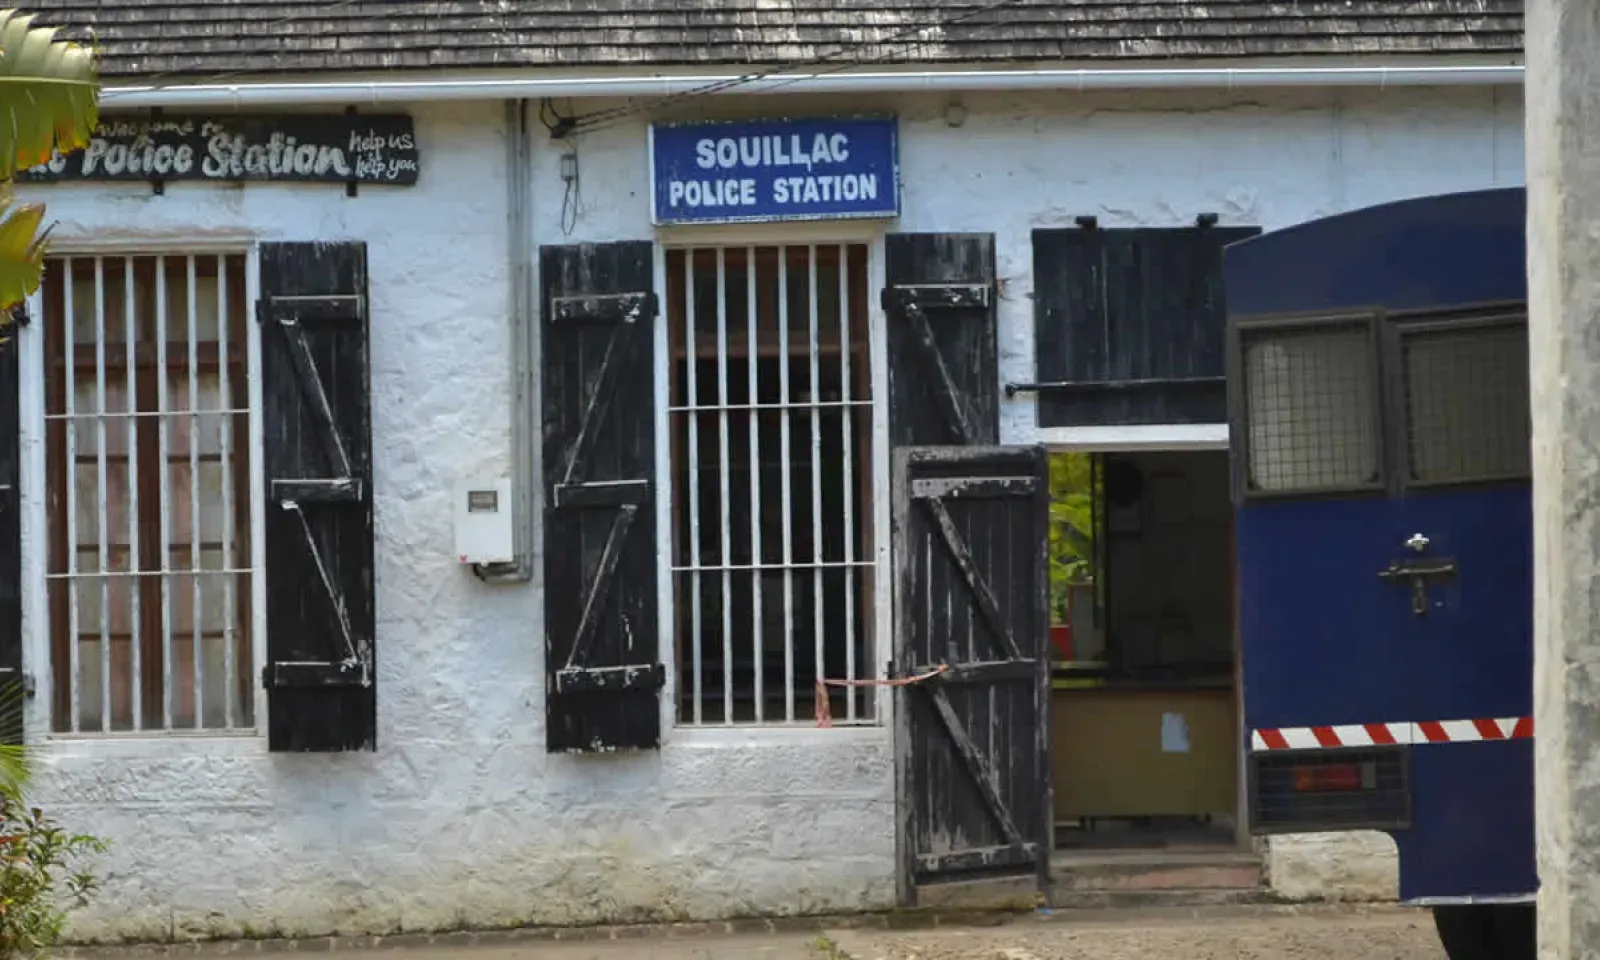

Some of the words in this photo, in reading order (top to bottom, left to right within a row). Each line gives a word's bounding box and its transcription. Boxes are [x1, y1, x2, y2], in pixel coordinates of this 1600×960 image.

[82, 137, 194, 176] Police
[202, 131, 352, 177] Station
[349, 128, 386, 160] help
[388, 133, 414, 149] us
[696, 132, 849, 169] SOUILLAC
[355, 152, 386, 179] help
[386, 158, 417, 179] you
[669, 178, 757, 207] POLICE
[772, 173, 877, 204] STATION
